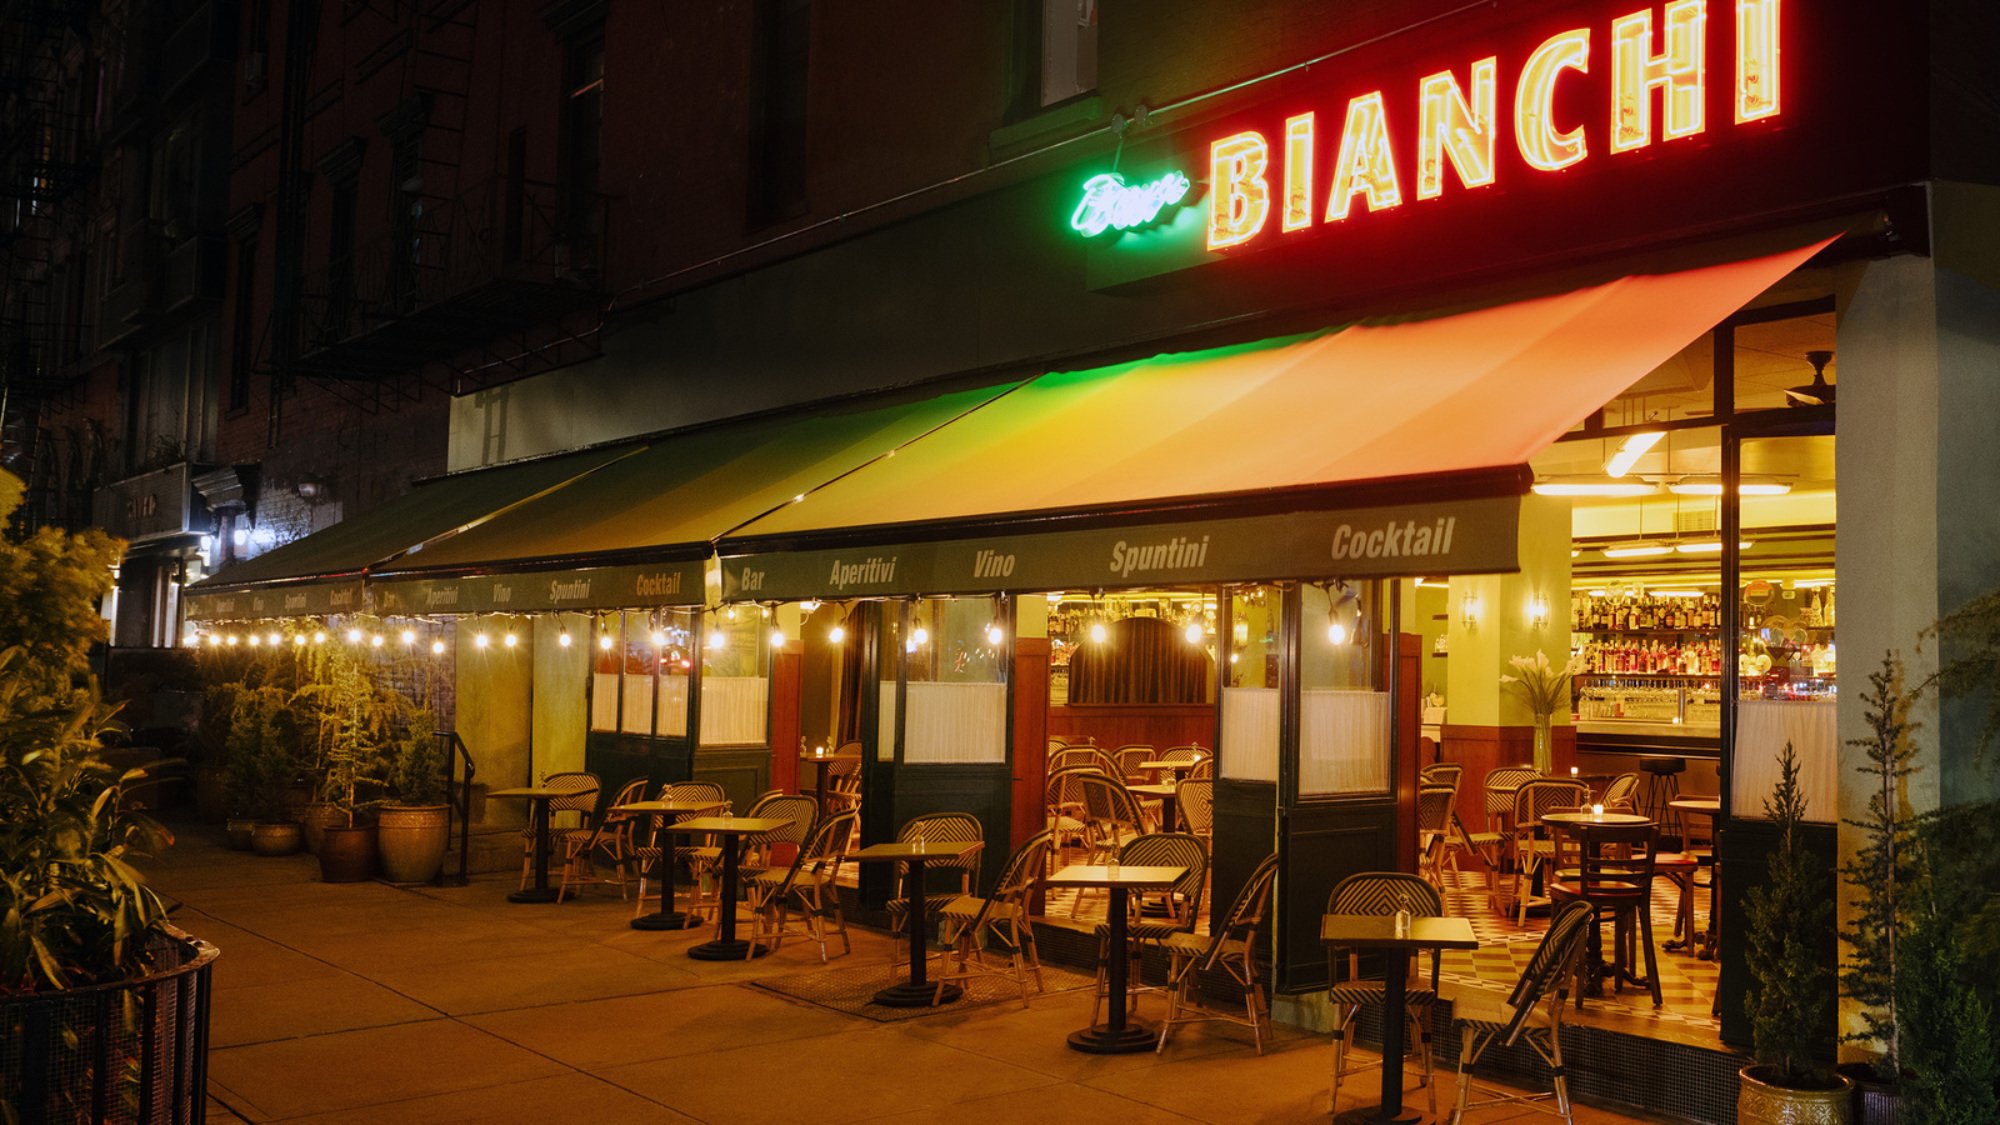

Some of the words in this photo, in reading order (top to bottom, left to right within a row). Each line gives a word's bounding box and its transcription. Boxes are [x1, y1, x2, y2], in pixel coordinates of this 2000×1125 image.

[1206, 0, 1781, 251] BIANCHI
[493, 583, 512, 602] Vino
[549, 579, 591, 604] Spuntini
[636, 571, 681, 596] Cocktail
[741, 567, 765, 592] Bar
[829, 556, 897, 590] Aperitivi
[974, 550, 1015, 578] Vino
[1109, 535, 1209, 578] Spuntini
[1331, 517, 1456, 561] Cocktail
